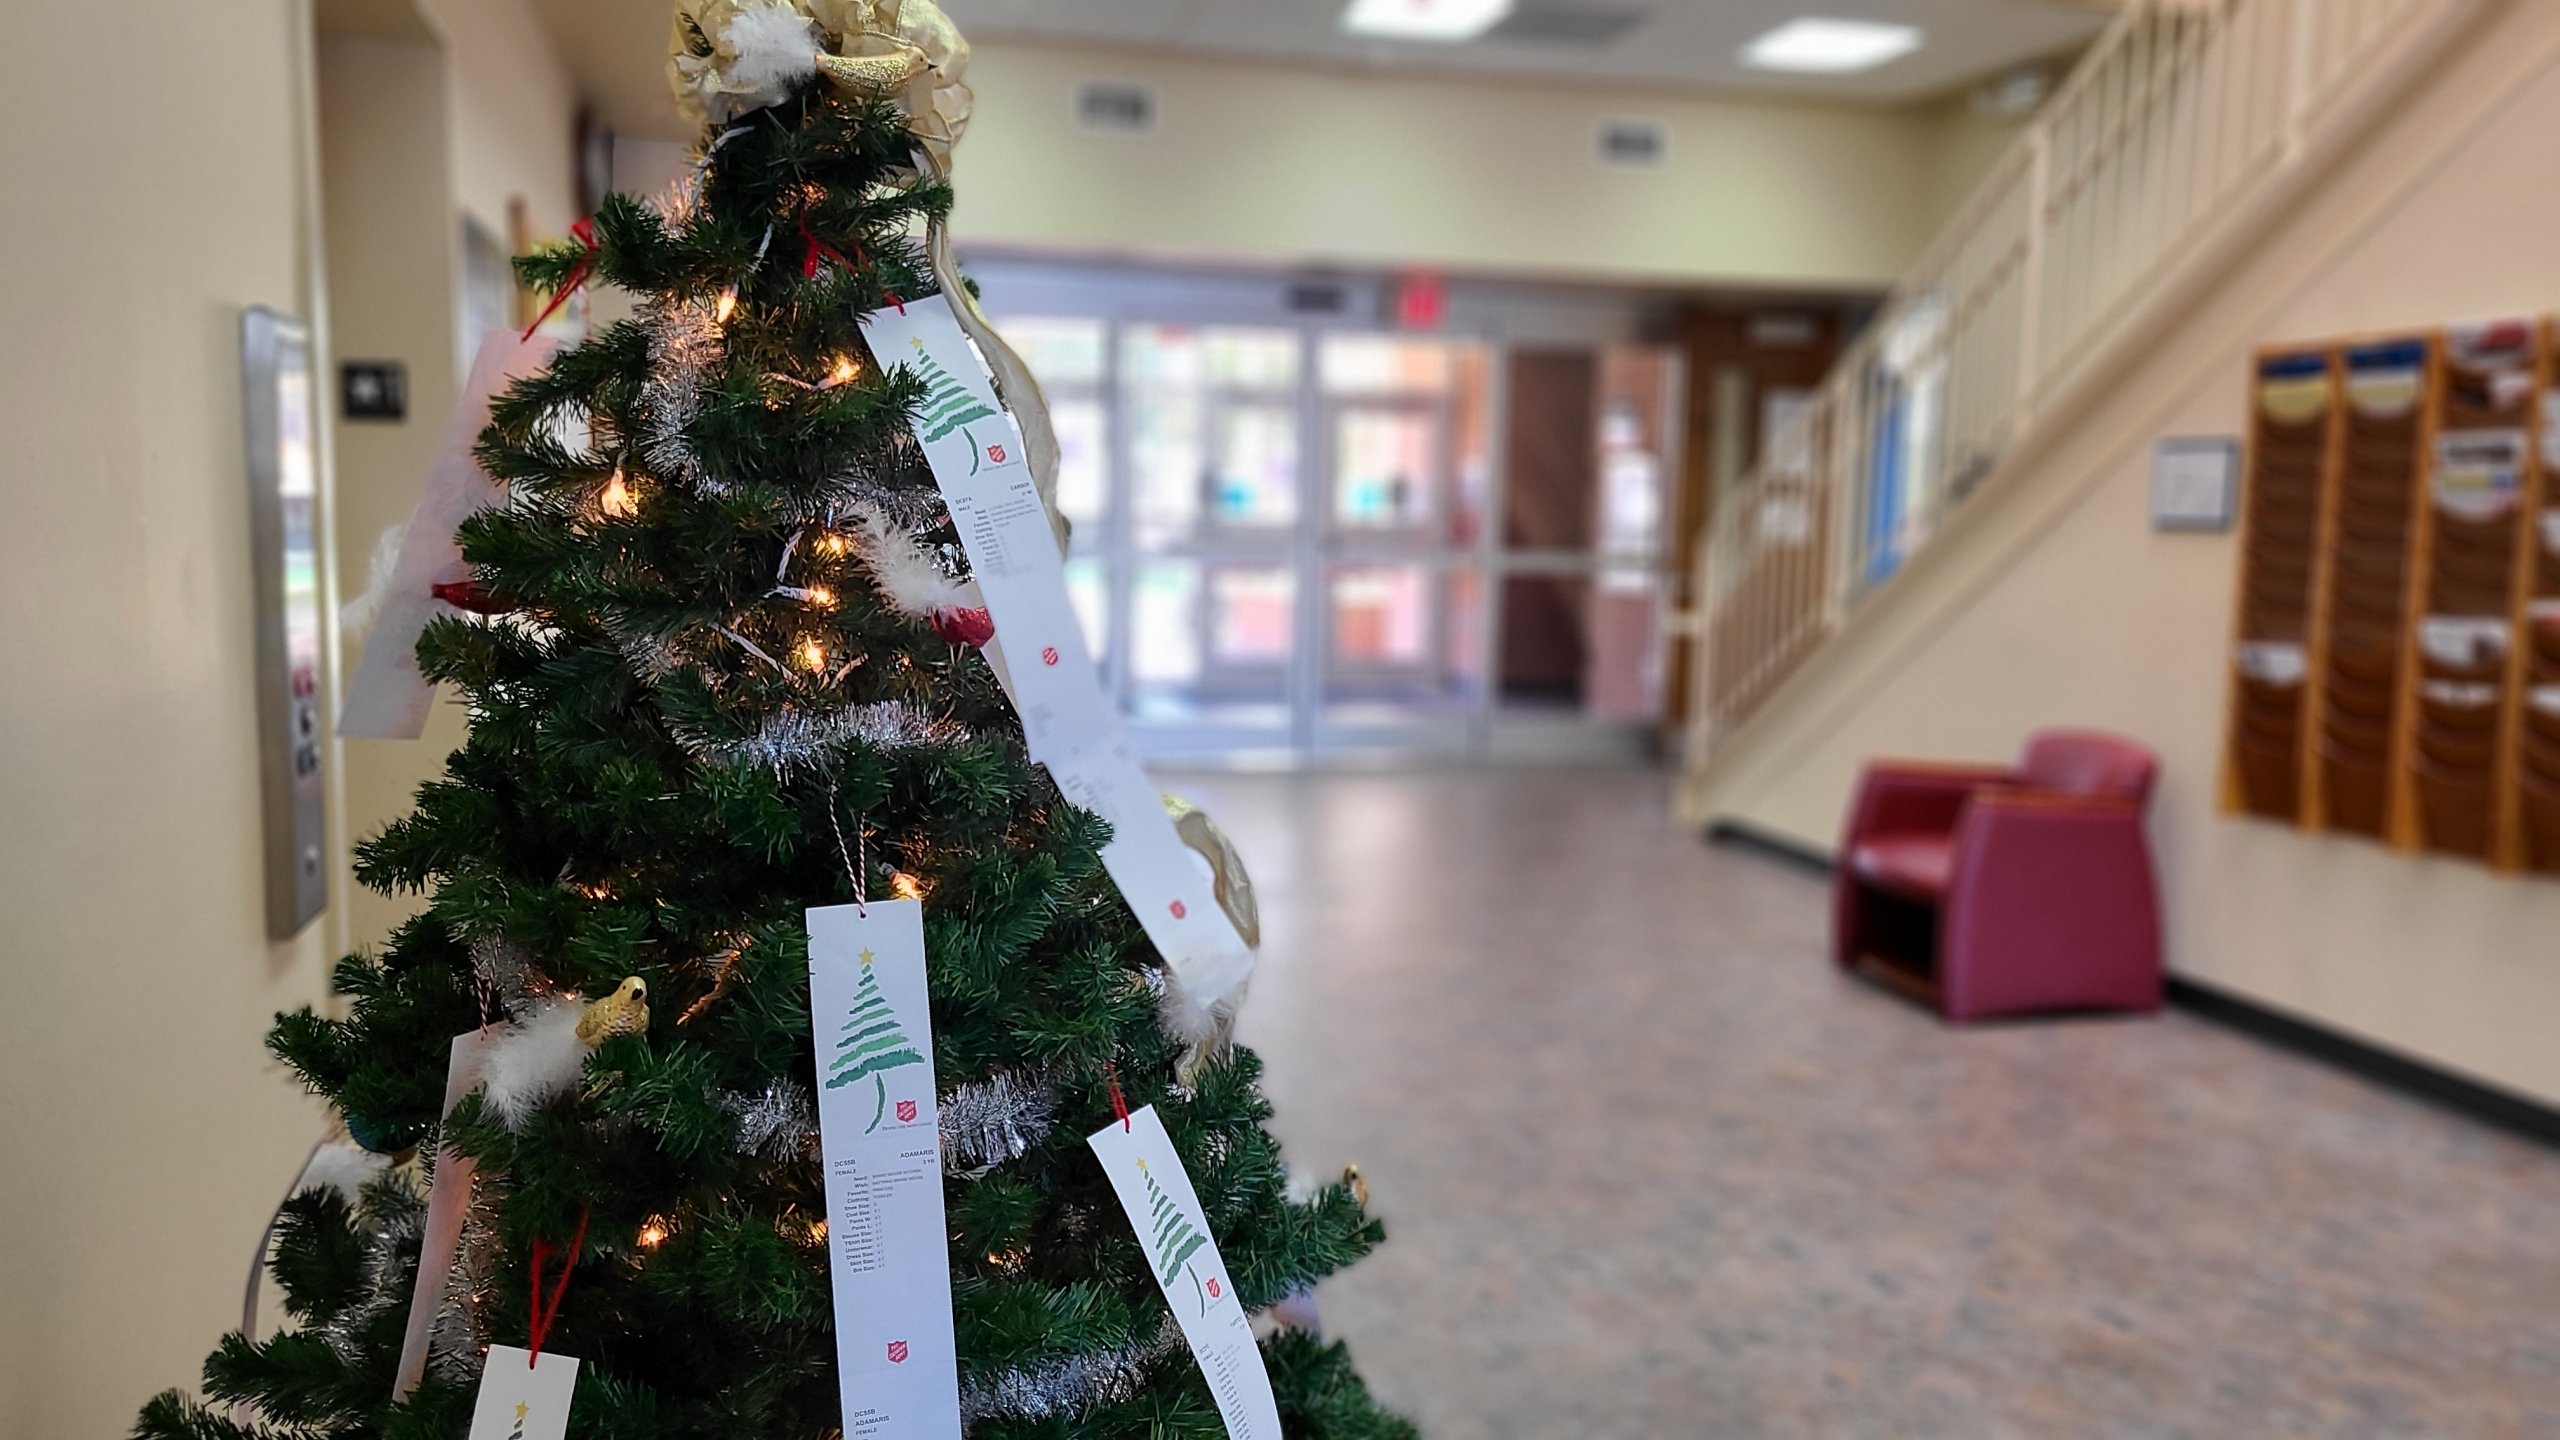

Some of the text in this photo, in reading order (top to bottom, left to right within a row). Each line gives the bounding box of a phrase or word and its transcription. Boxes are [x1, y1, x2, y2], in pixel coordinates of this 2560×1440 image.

[900, 1149, 934, 1158] ADAMARIS
[855, 1415, 890, 1426] ADAMARIS
[855, 1428, 878, 1436] FEMALE
